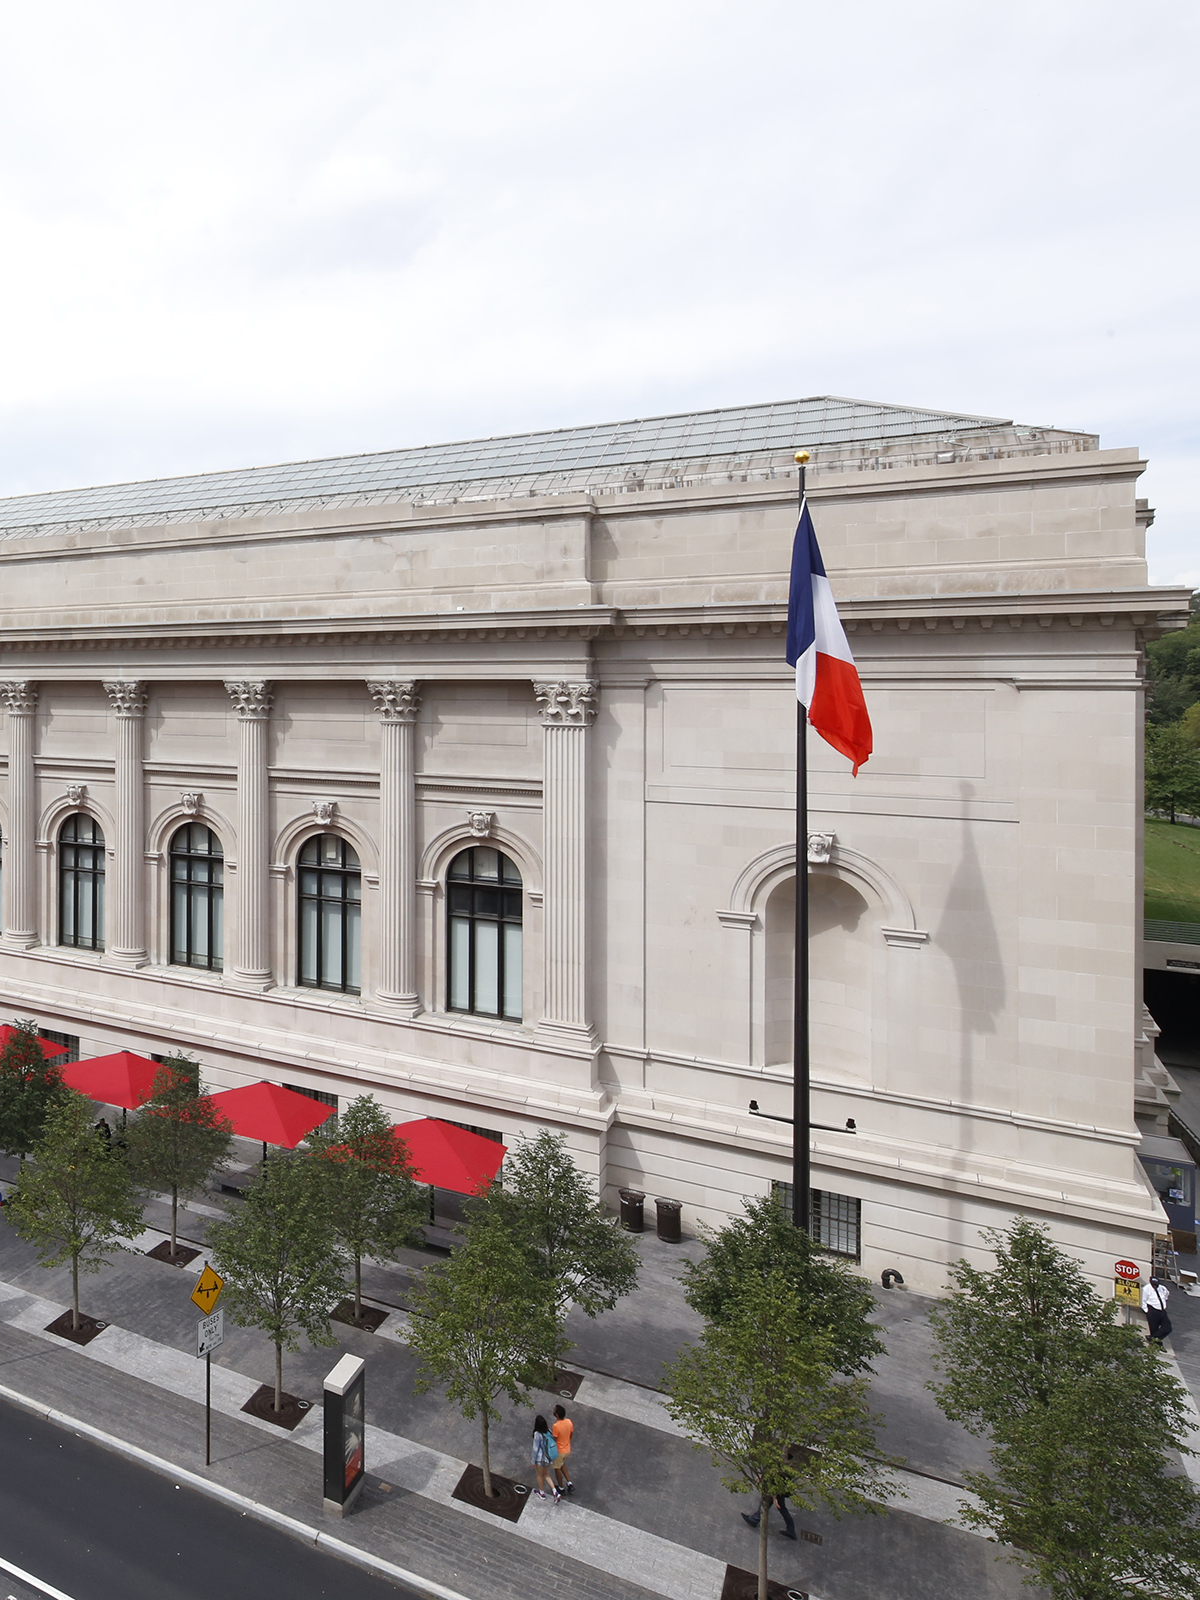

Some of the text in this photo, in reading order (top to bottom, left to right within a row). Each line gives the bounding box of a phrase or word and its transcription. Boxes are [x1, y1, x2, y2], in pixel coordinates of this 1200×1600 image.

[1115, 1264, 1139, 1276] STOP
[1117, 1278, 1138, 1288] SLOW
[202, 1313, 220, 1330] BUSES
[204, 1323, 218, 1338] ONLY
